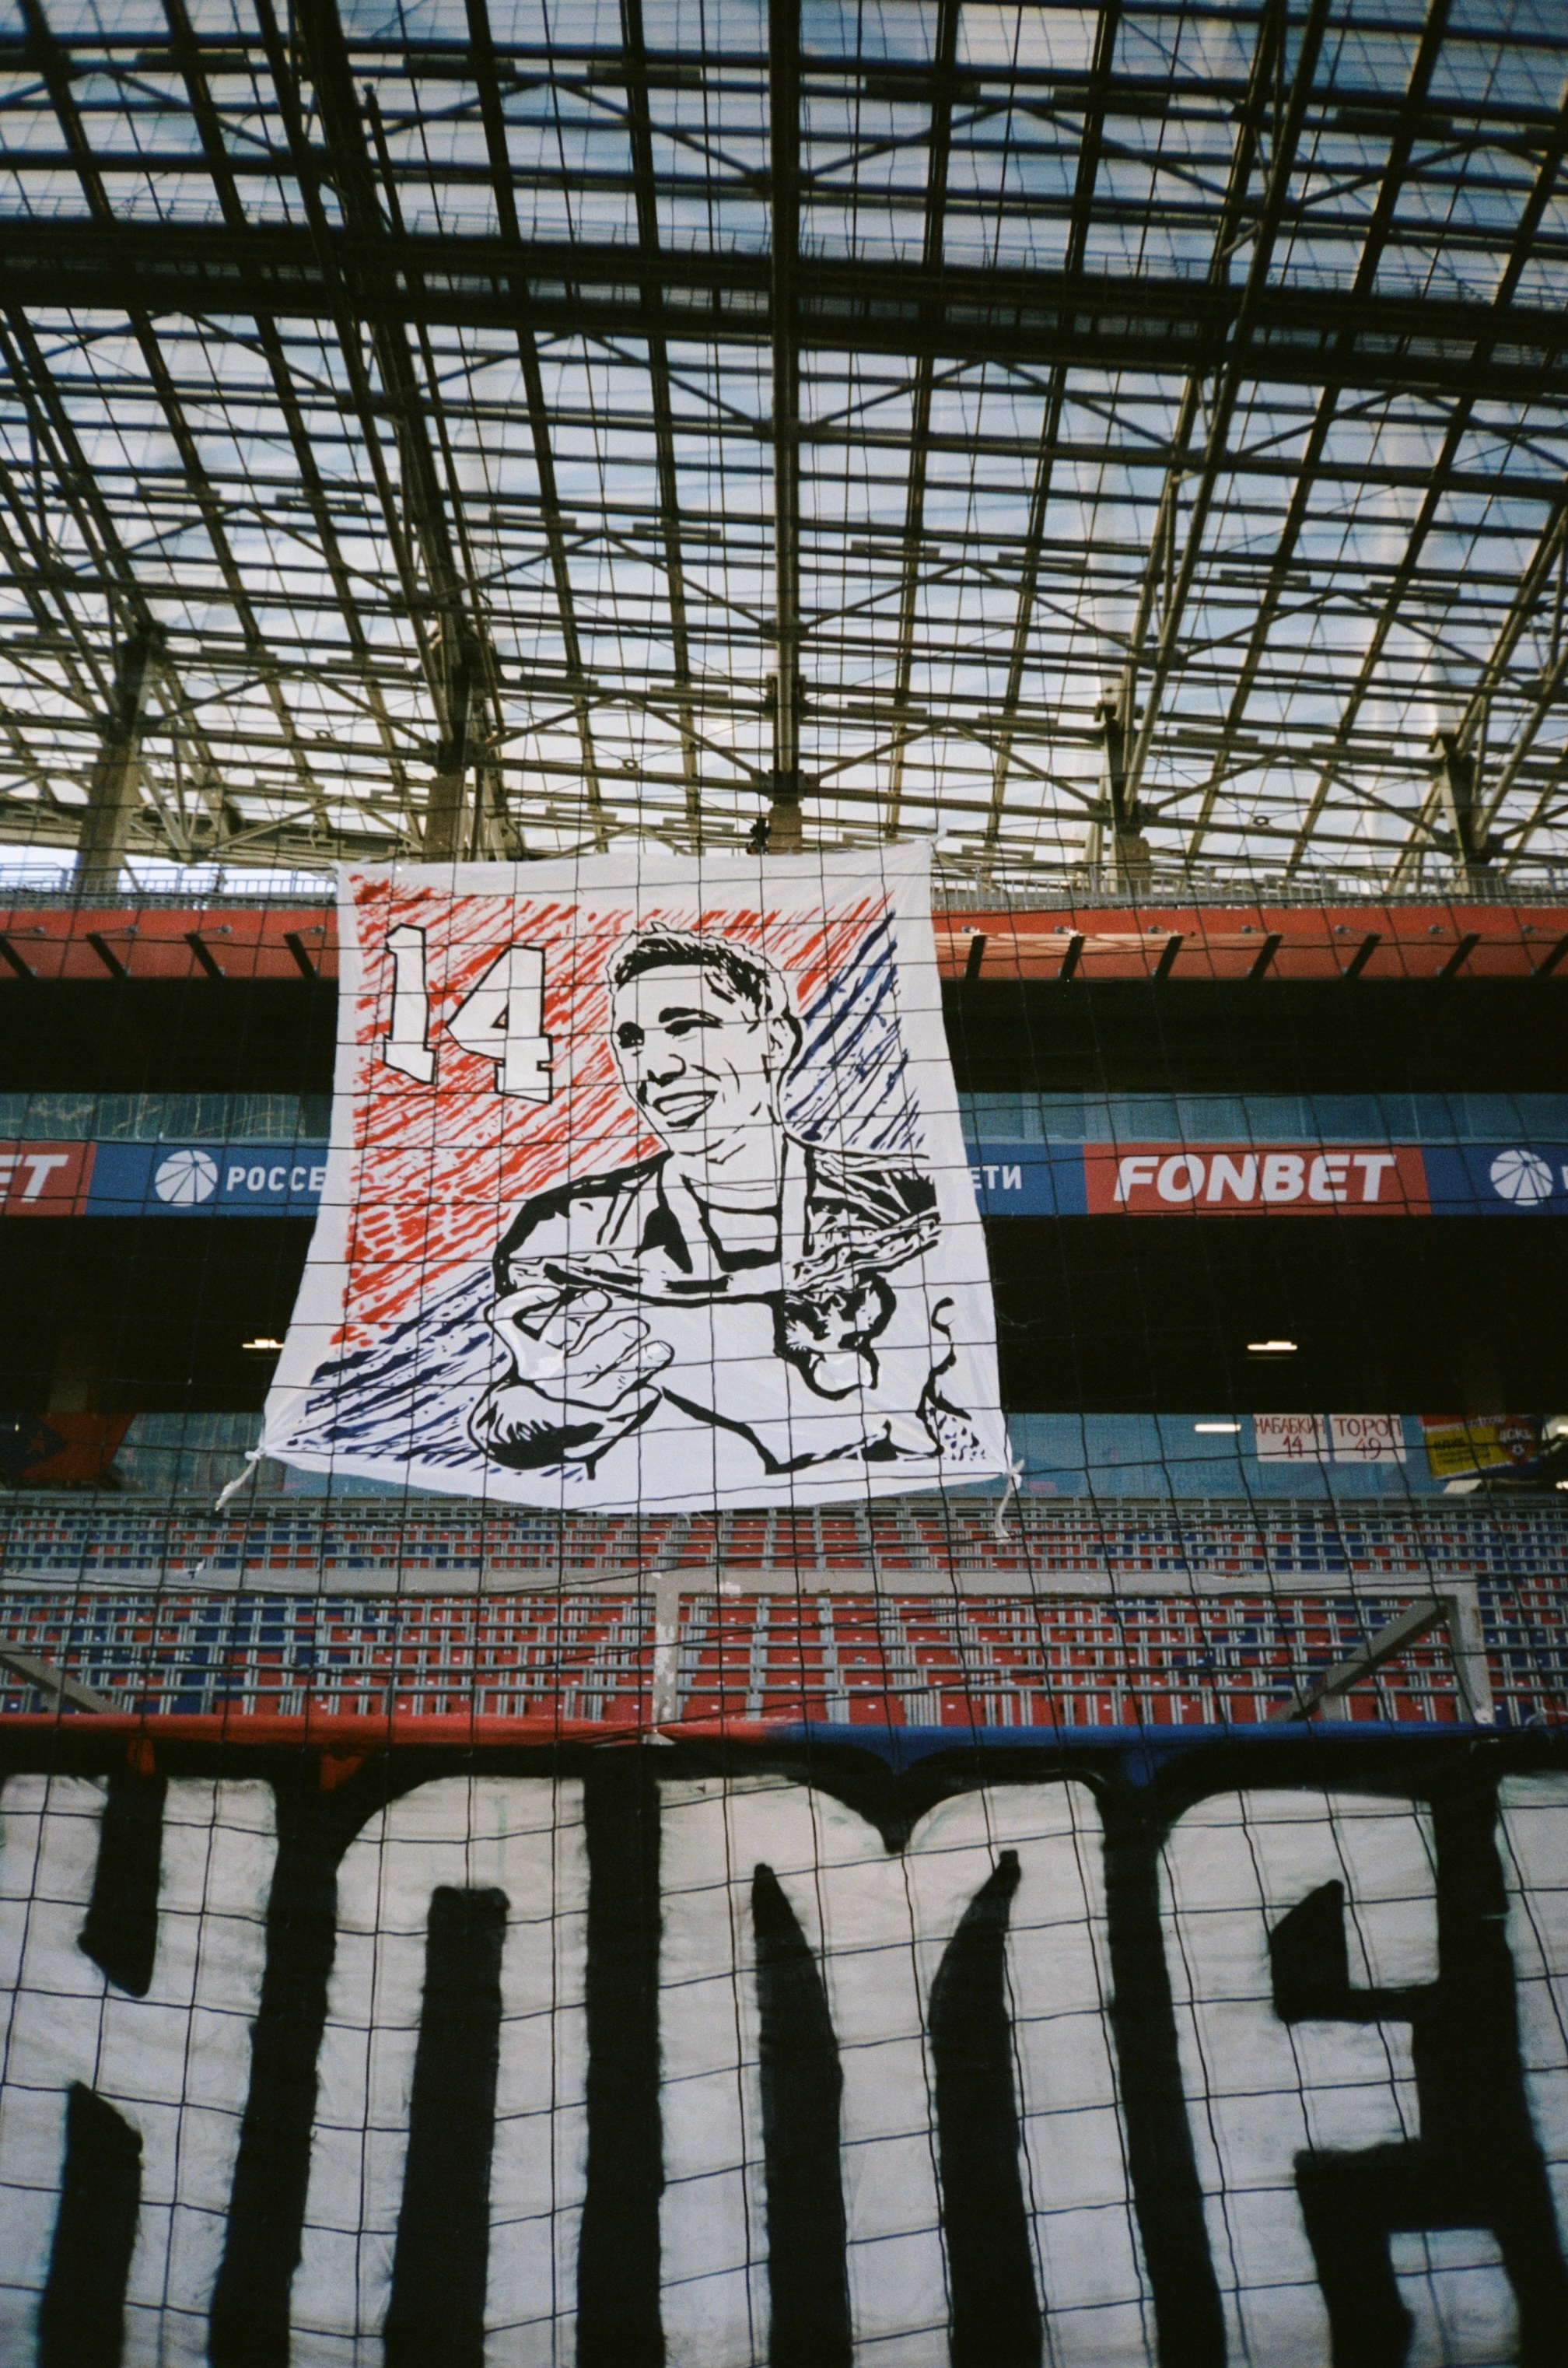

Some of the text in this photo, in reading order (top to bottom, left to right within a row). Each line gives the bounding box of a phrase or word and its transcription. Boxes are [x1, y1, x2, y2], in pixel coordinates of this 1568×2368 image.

[383, 923, 553, 1104] 14
[226, 1166, 326, 1191] РОССЕ
[1114, 1154, 1396, 1202] FONBET
[1254, 1417, 1325, 1434] НАБАБКИН
[1334, 1417, 1402, 1437] ТОРОП
[1283, 1435, 1303, 1459] 14
[1355, 1438, 1381, 1460] 49
